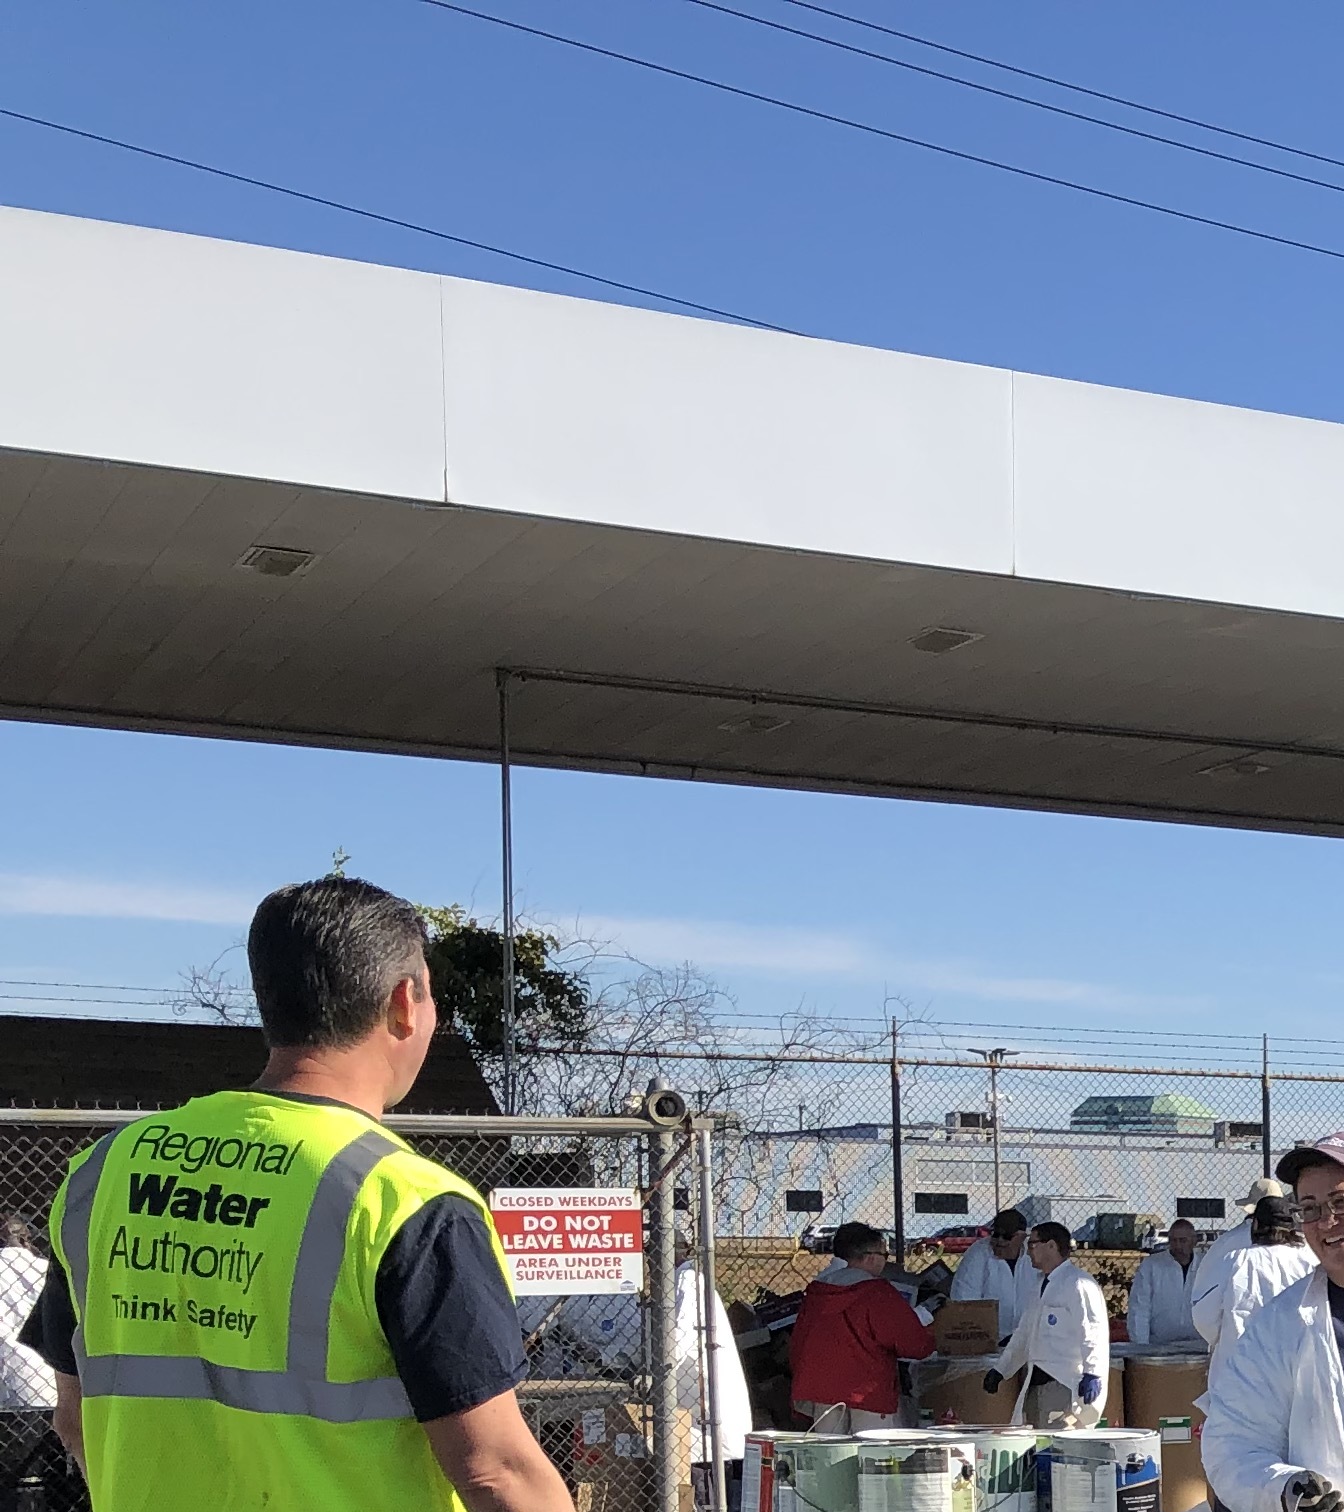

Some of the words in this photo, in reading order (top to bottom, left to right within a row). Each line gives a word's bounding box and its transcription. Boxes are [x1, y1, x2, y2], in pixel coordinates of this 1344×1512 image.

[130, 1125, 304, 1175] Regional
[128, 1173, 271, 1228] Water
[500, 1196, 554, 1207] CLOSED
[558, 1196, 633, 1207] WEEKDAYS
[523, 1215, 557, 1231] DO
[565, 1215, 612, 1231] NOT
[503, 1233, 563, 1249] LEAVE
[568, 1233, 634, 1249] WASTE
[109, 1225, 264, 1294] Authority
[516, 1257, 558, 1268] AREA
[565, 1257, 622, 1267] UNDER
[516, 1269, 623, 1280] SURVEILLANCE
[112, 1295, 177, 1322] Think
[187, 1299, 258, 1339] Safety
